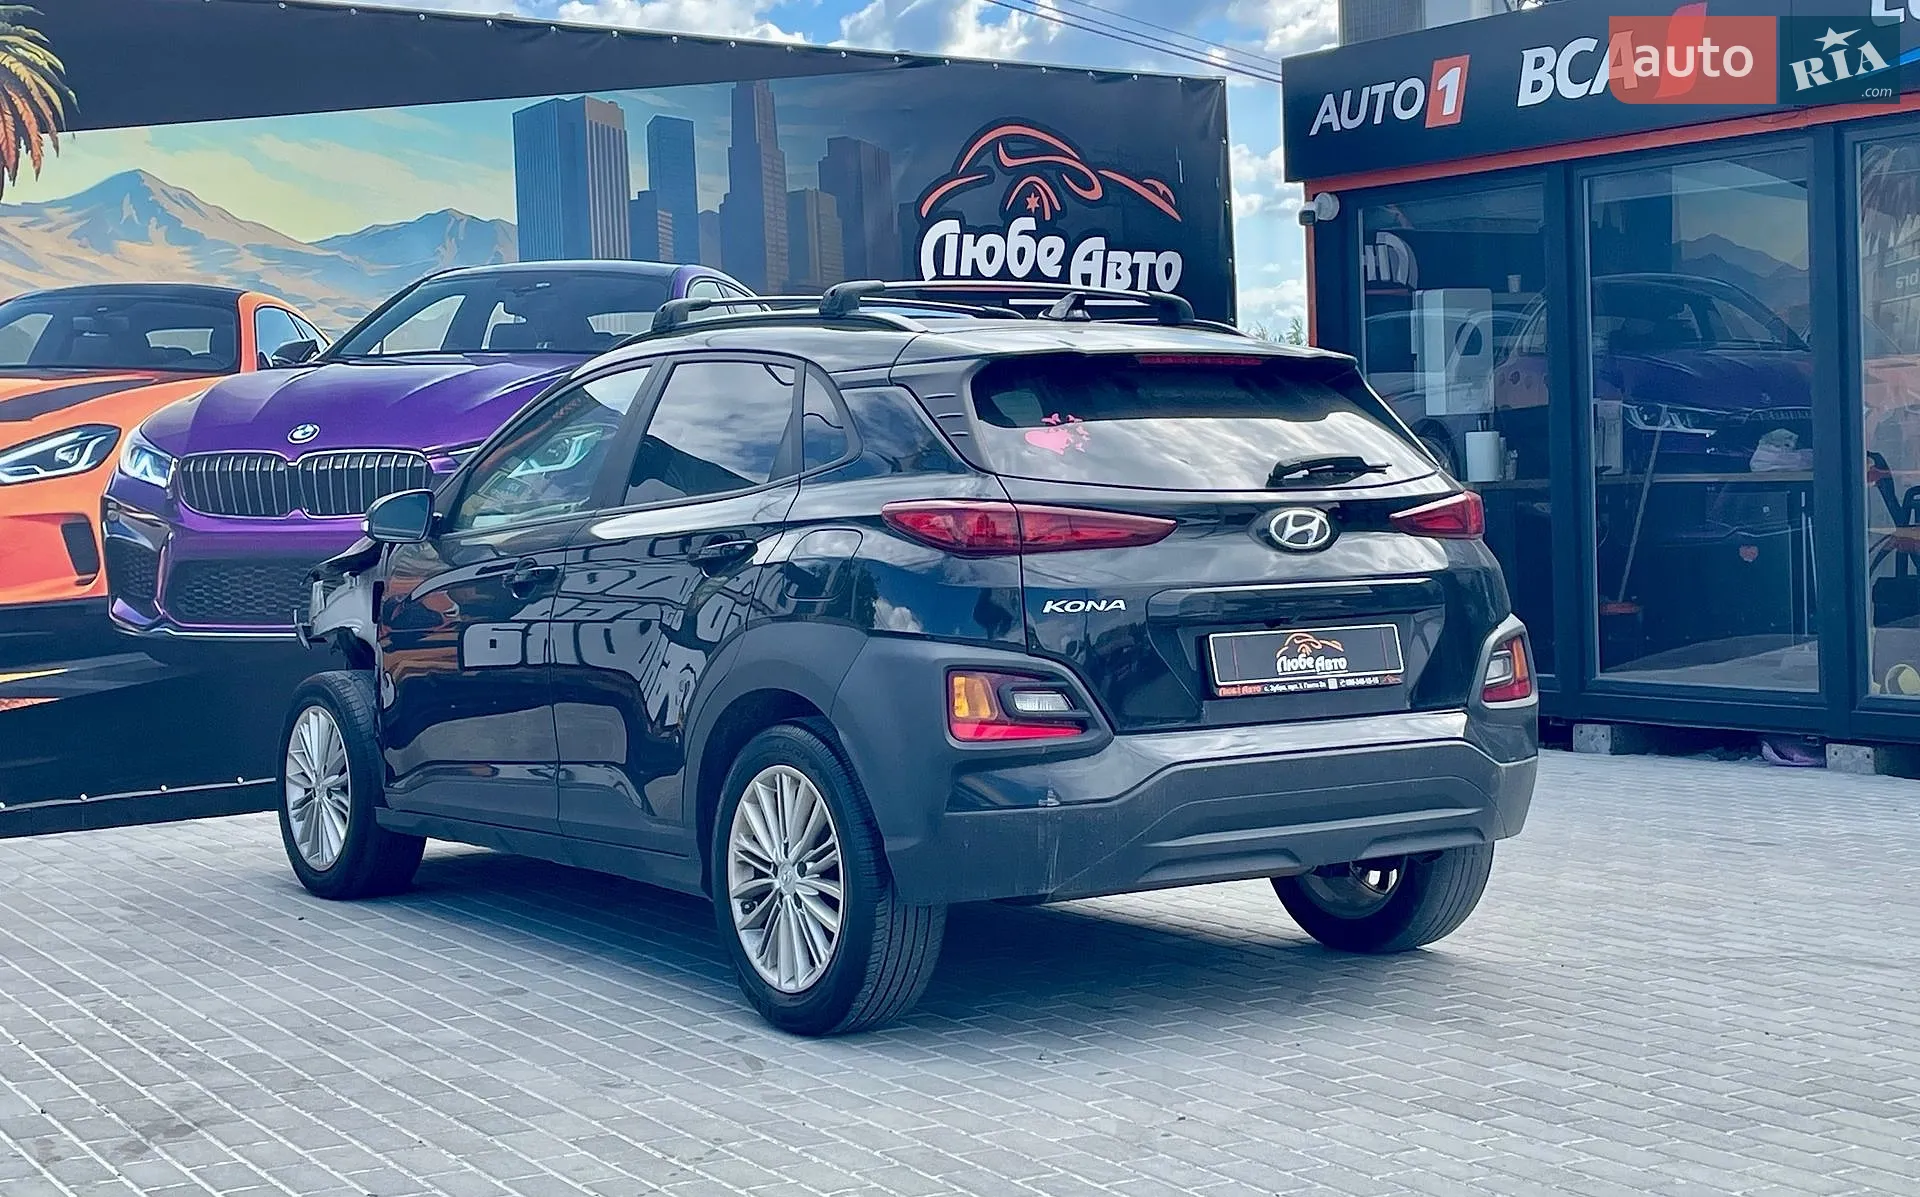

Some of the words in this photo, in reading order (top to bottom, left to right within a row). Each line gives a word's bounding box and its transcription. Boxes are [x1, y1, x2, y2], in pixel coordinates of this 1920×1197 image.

[1308, 66, 1462, 137] AUTO1
[1516, 29, 1639, 108] BCA
[920, 216, 1066, 282] Любе
[1069, 236, 1183, 293] Авто
[1042, 599, 1127, 614] KONA
[1276, 653, 1315, 673] Любе
[1315, 655, 1348, 673] Авто
